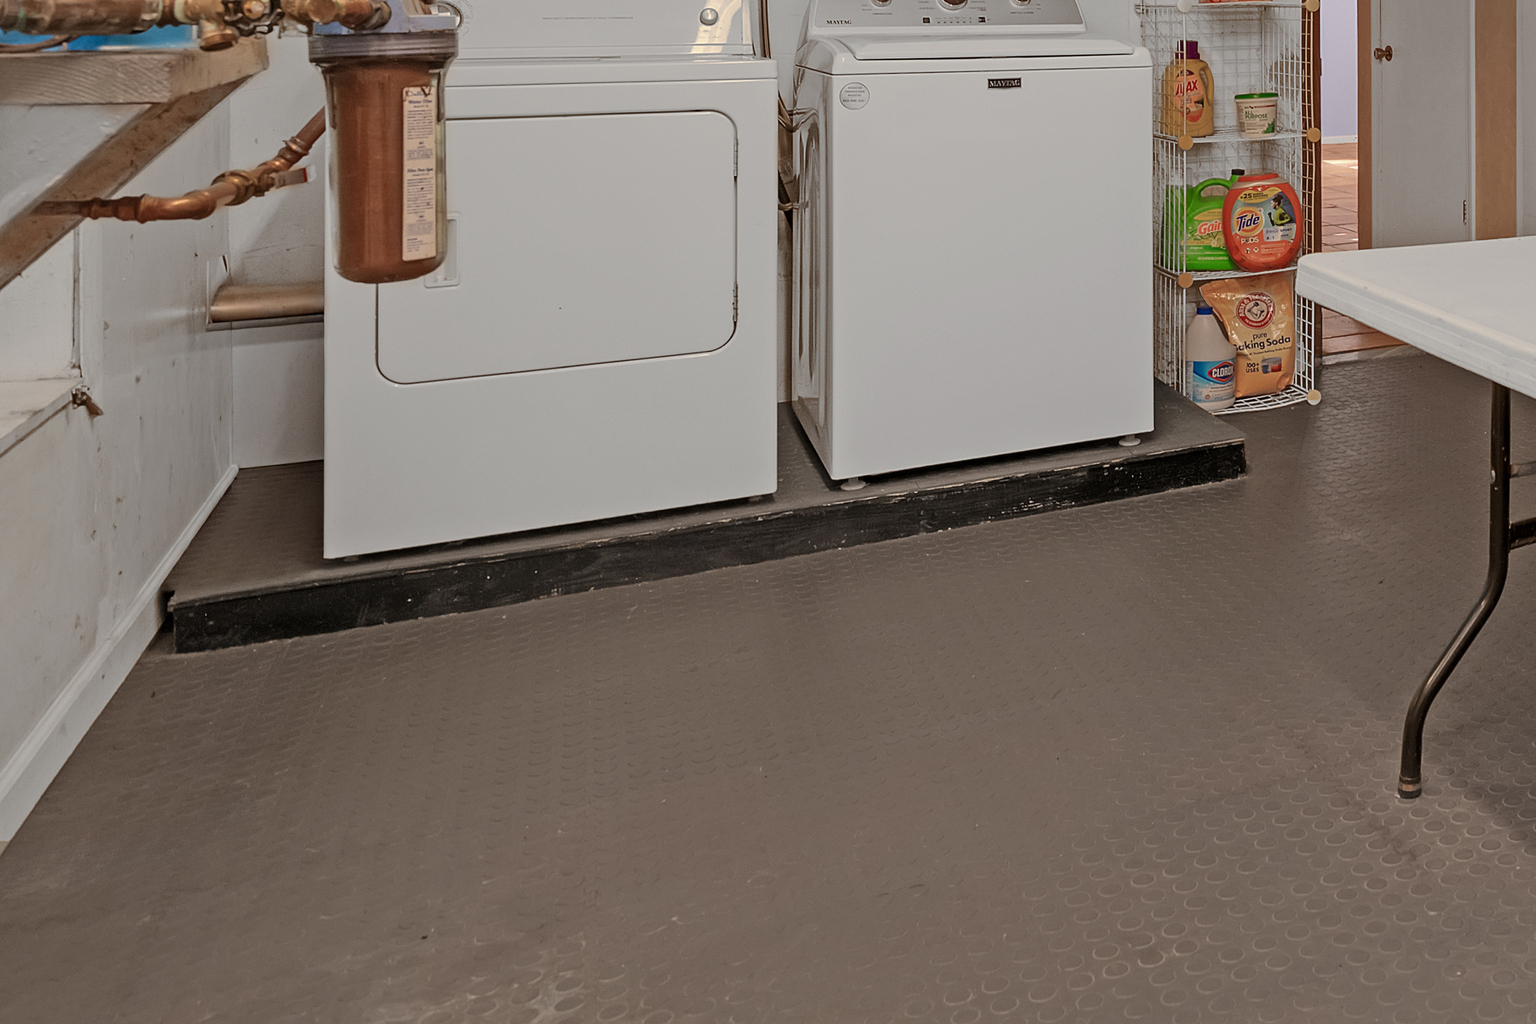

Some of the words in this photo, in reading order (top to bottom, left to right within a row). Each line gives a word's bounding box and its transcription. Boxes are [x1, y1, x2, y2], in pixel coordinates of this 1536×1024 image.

[989, 79, 1021, 87] MAYTAG
[1197, 220, 1224, 235] Gain
[1236, 214, 1260, 232] Tide
[1252, 333, 1268, 341] pure
[1266, 336, 1291, 347] Soda
